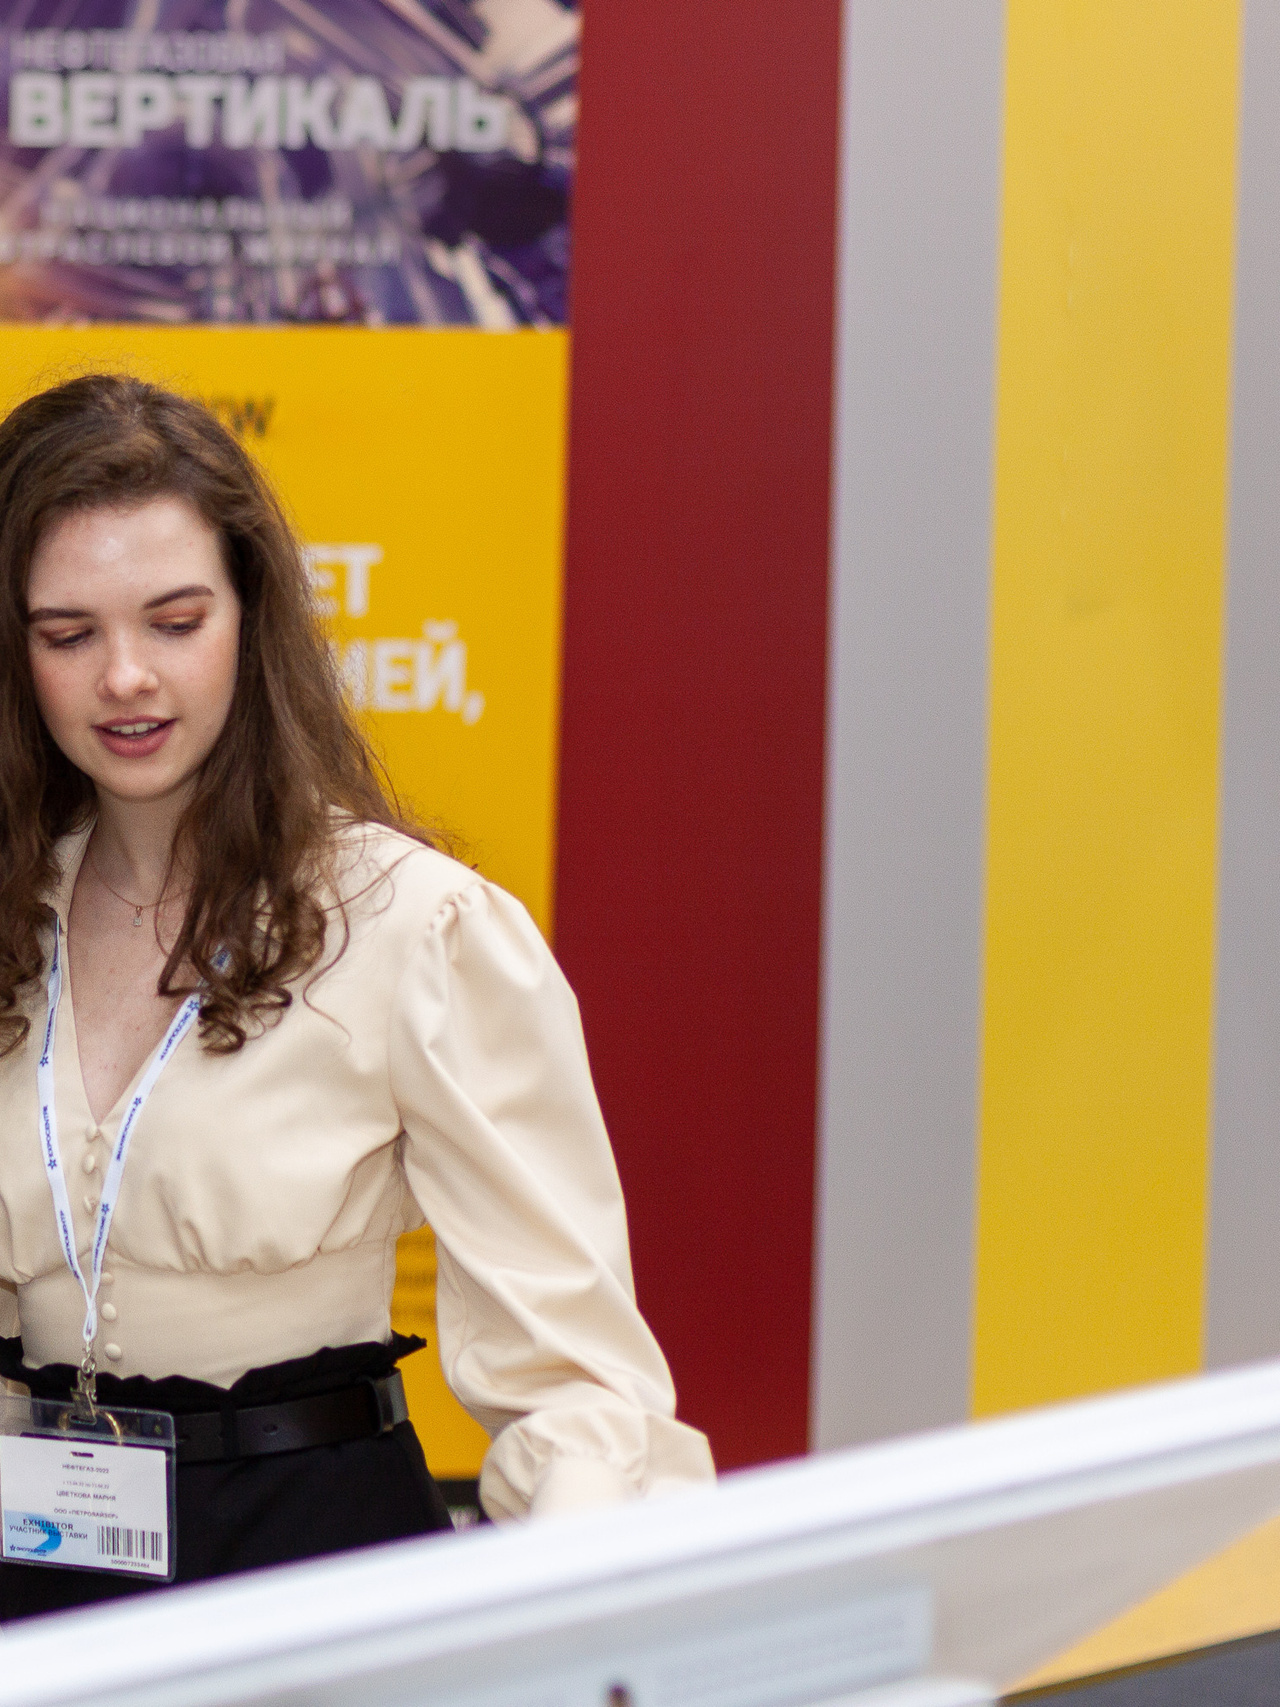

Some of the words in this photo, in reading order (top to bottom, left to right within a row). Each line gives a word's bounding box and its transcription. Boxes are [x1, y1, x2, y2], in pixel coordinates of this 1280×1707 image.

[11, 73, 508, 151] ВЕРТИКАЛЬ
[56, 1490, 91, 1499] ЦВЕТКОВА
[23, 1518, 74, 1530] EXHIBITOR
[9, 1525, 47, 1535] УЧАСТНИК
[47, 1529, 88, 1540] ВЫСТАВКИ
